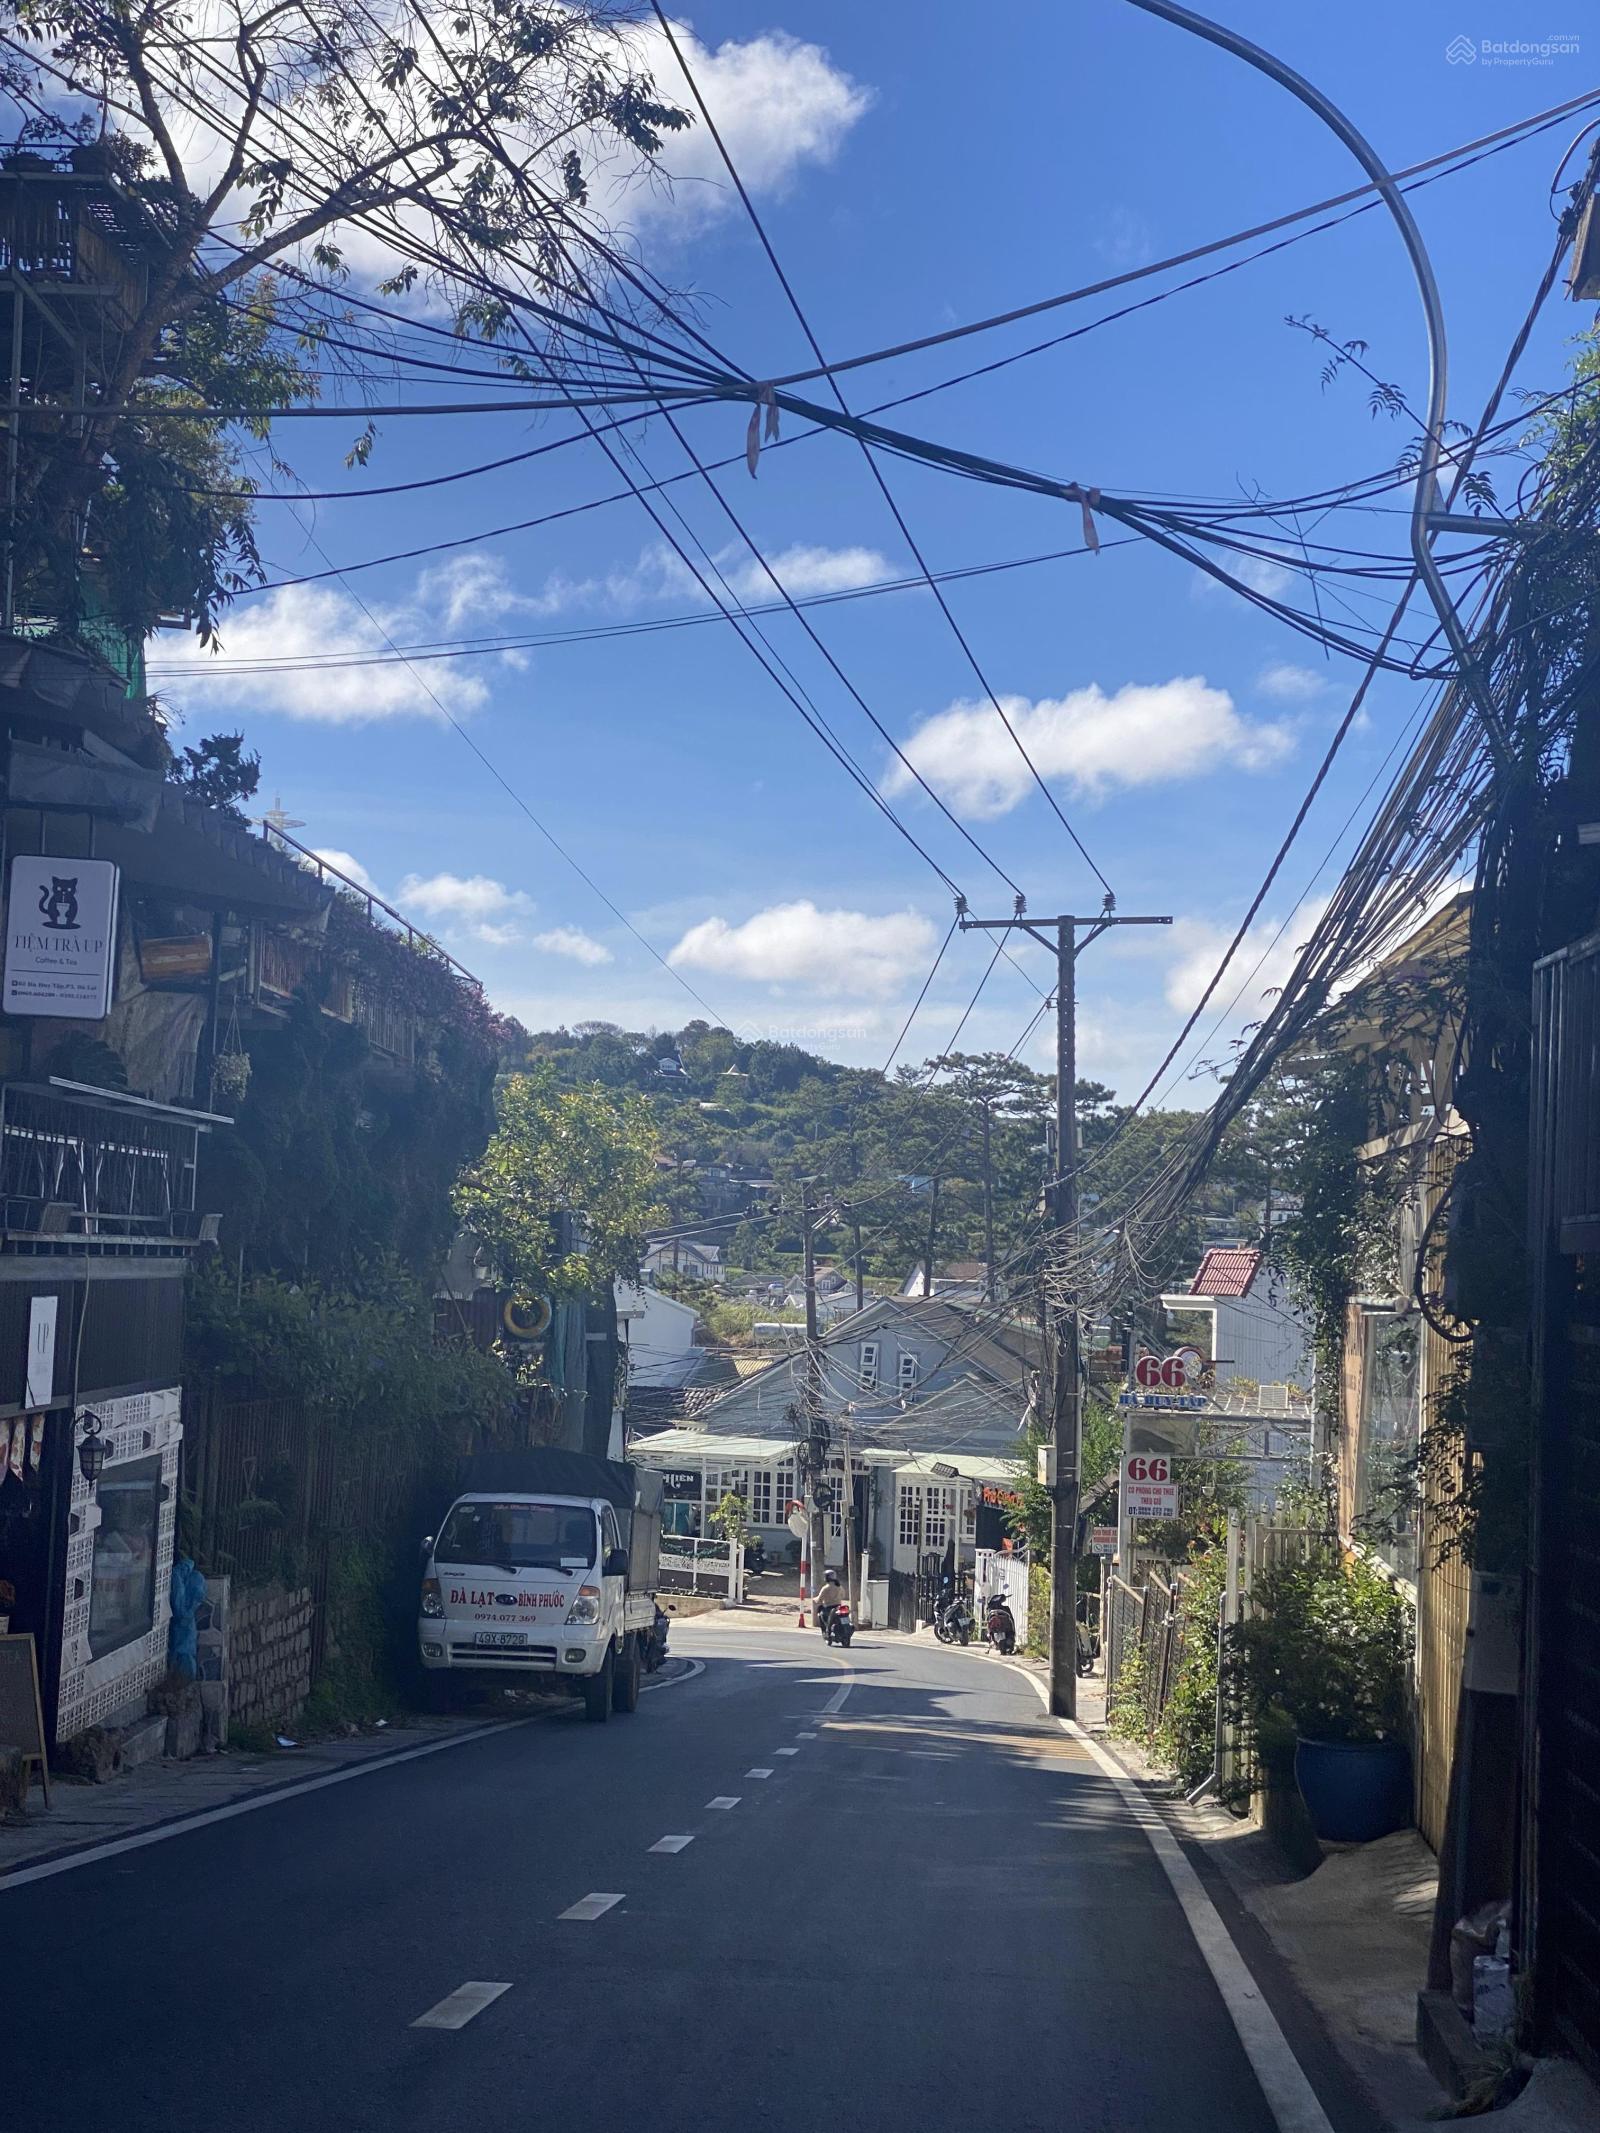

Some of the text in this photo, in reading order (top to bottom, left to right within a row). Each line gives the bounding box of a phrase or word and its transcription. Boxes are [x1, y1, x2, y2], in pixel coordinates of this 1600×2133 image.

[15, 932, 104, 953] TIỆM TRÀ UP
[35, 956, 78, 966] Coffee & Tea
[1136, 1356, 1186, 1387] 66
[1128, 1458, 1168, 1481] 66
[471, 1590, 495, 1608] LẠT
[518, 1589, 537, 1607] BÌNH
